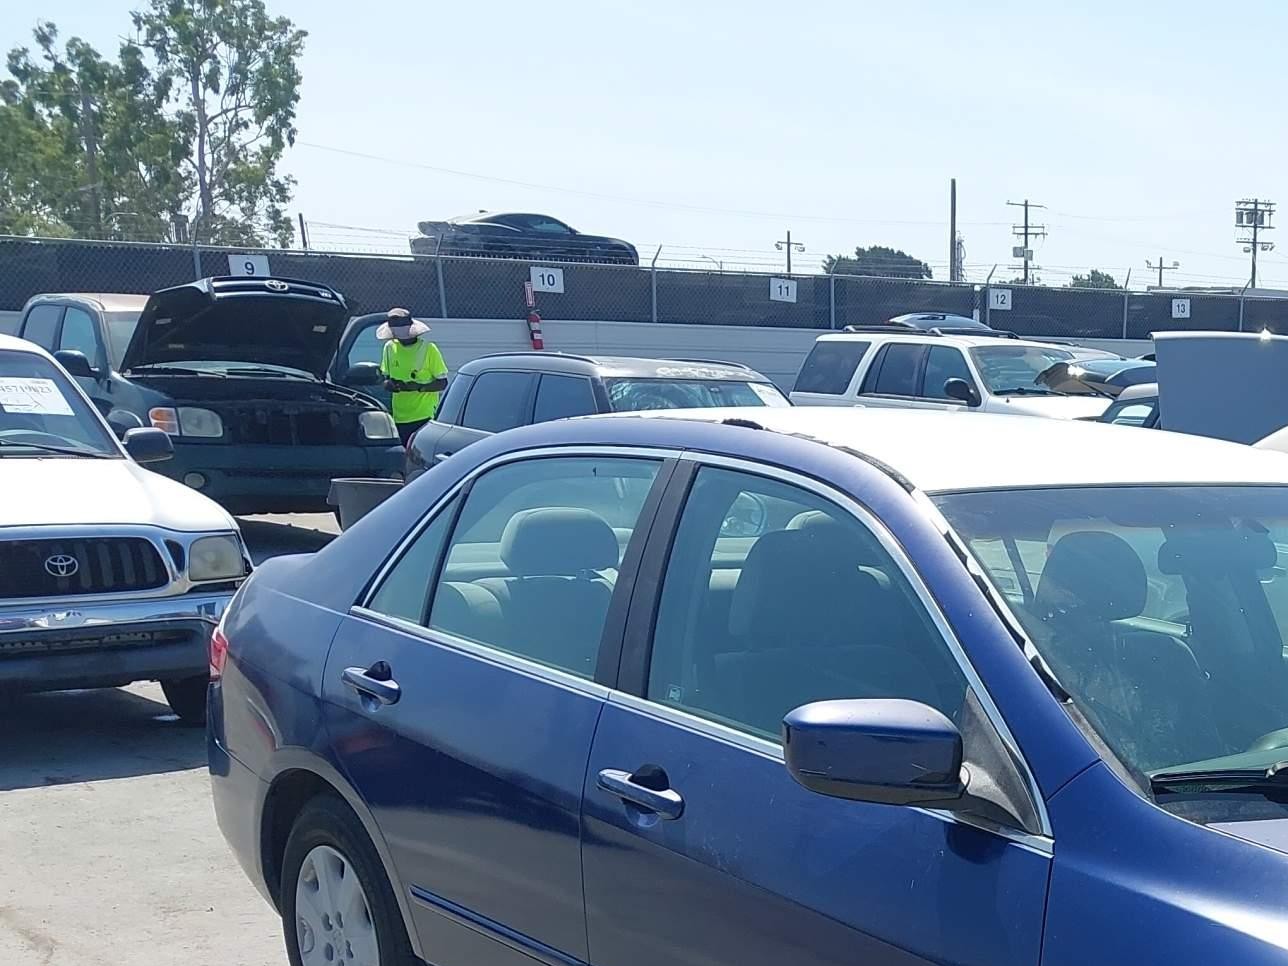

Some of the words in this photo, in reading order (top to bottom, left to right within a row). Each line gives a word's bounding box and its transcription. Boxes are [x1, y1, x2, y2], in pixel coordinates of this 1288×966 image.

[244, 262, 255, 275] 9
[539, 272, 555, 286] 10
[777, 284, 790, 296] 11
[995, 294, 1006, 305] 12
[1176, 303, 1186, 313] 13
